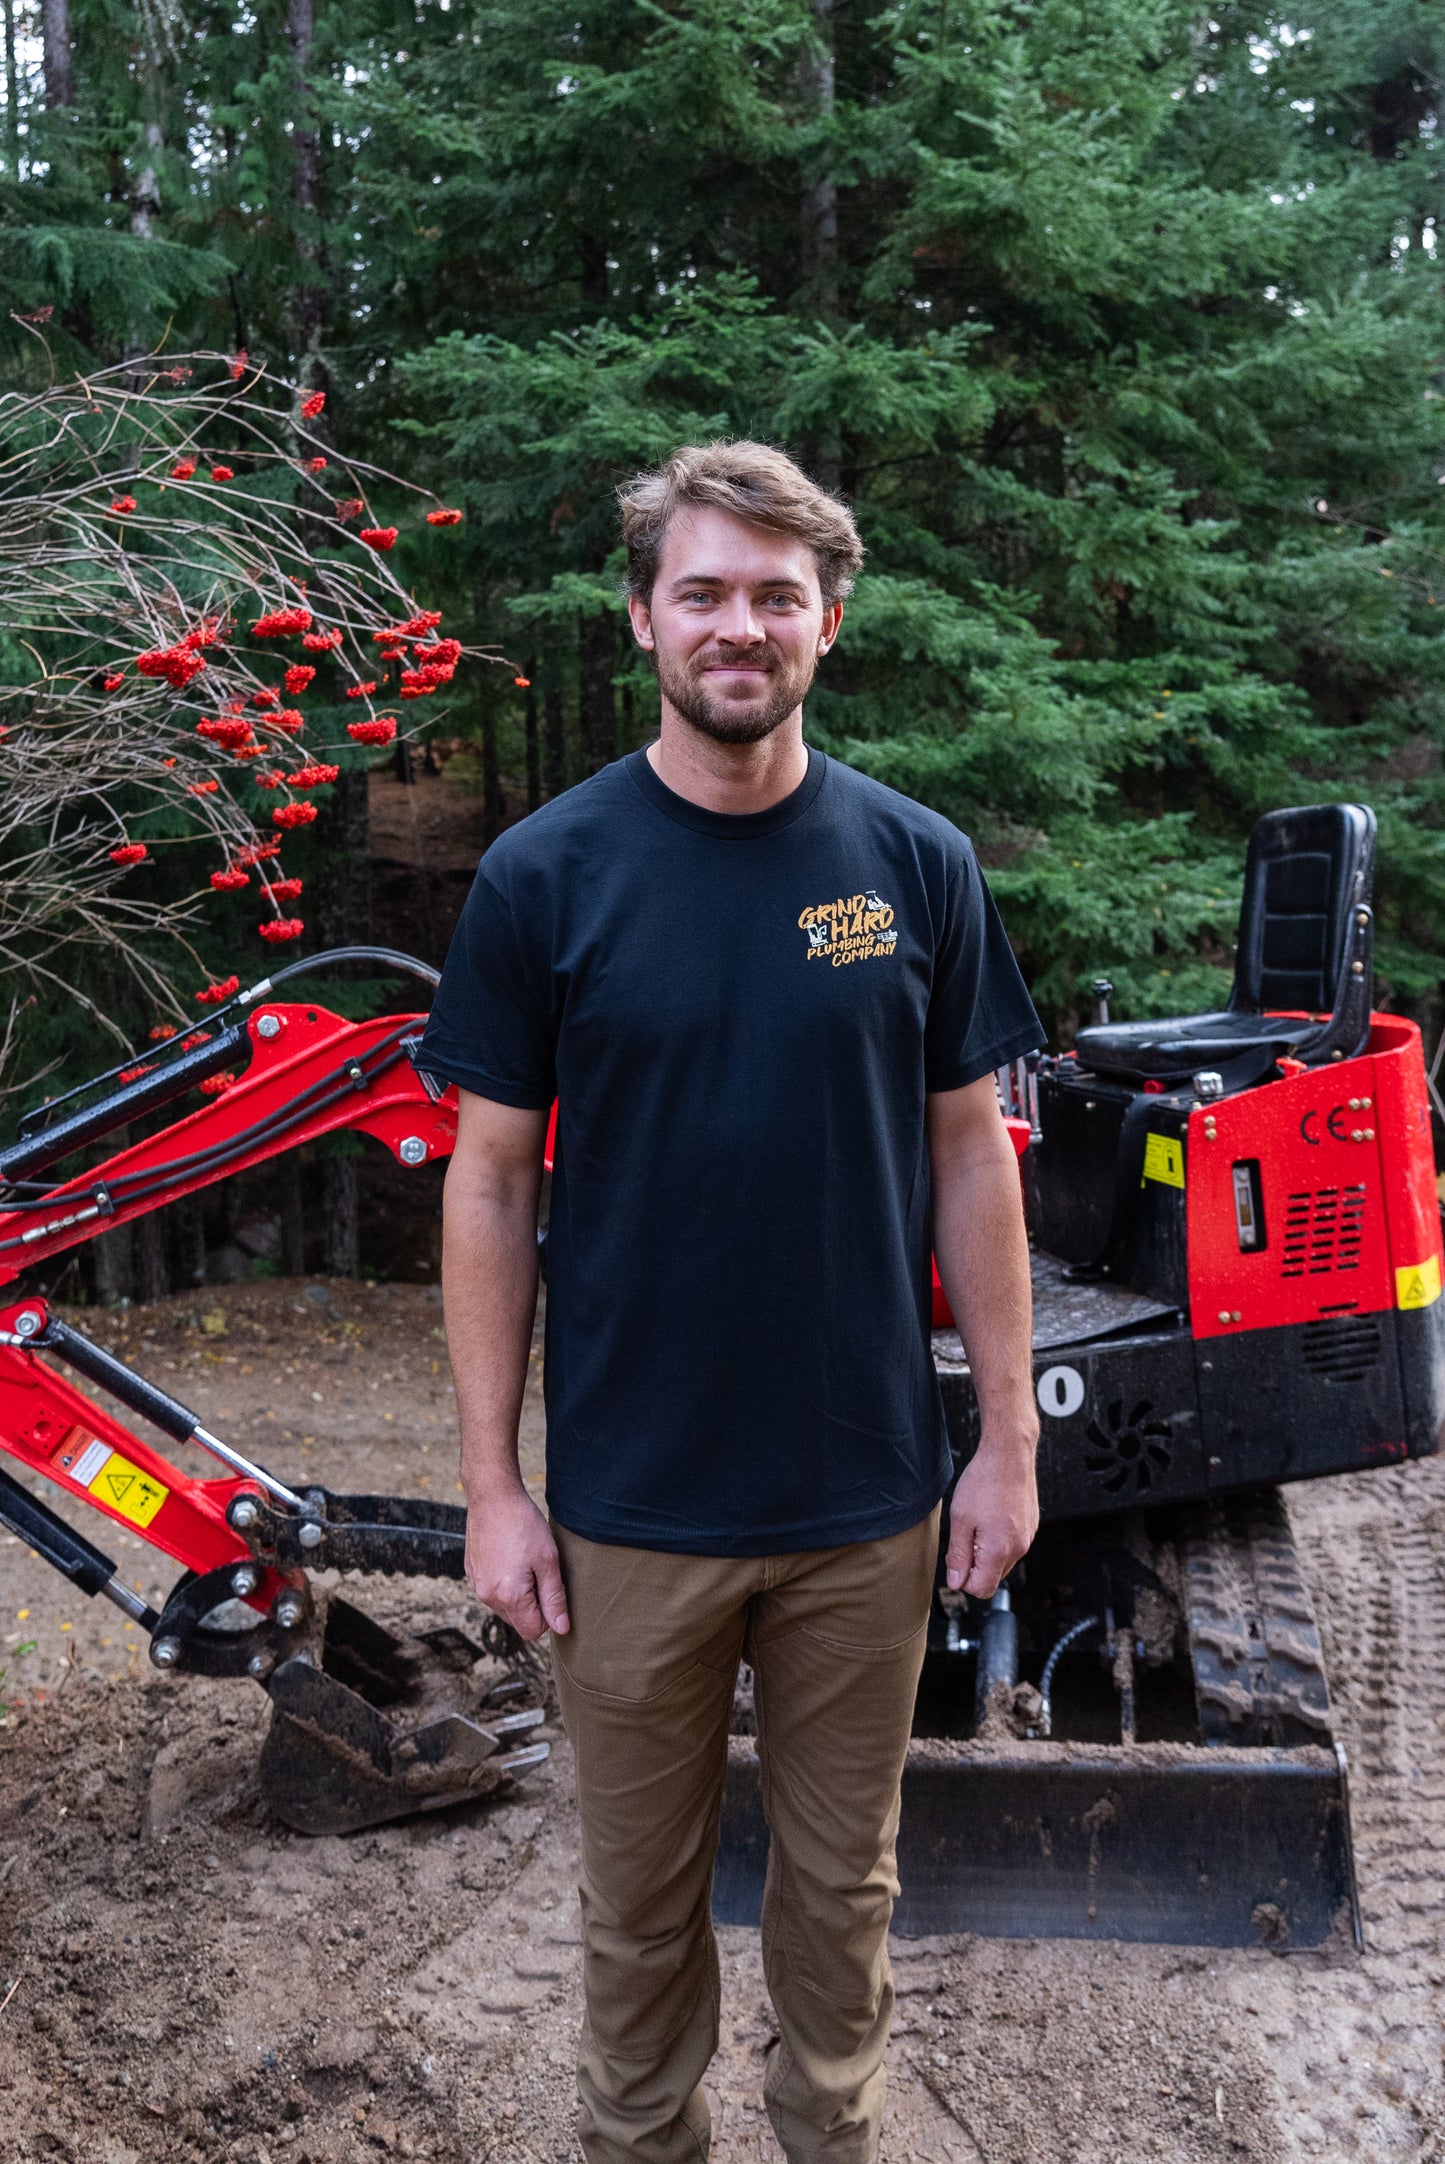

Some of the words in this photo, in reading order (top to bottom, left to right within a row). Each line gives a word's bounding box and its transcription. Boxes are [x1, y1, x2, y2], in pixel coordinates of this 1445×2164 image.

[798, 894, 867, 929] GRIND
[831, 907, 895, 941] HARD
[807, 933, 877, 961] PLUMBING
[831, 941, 897, 967] COMPANY
[1300, 1106, 1348, 1145] CE
